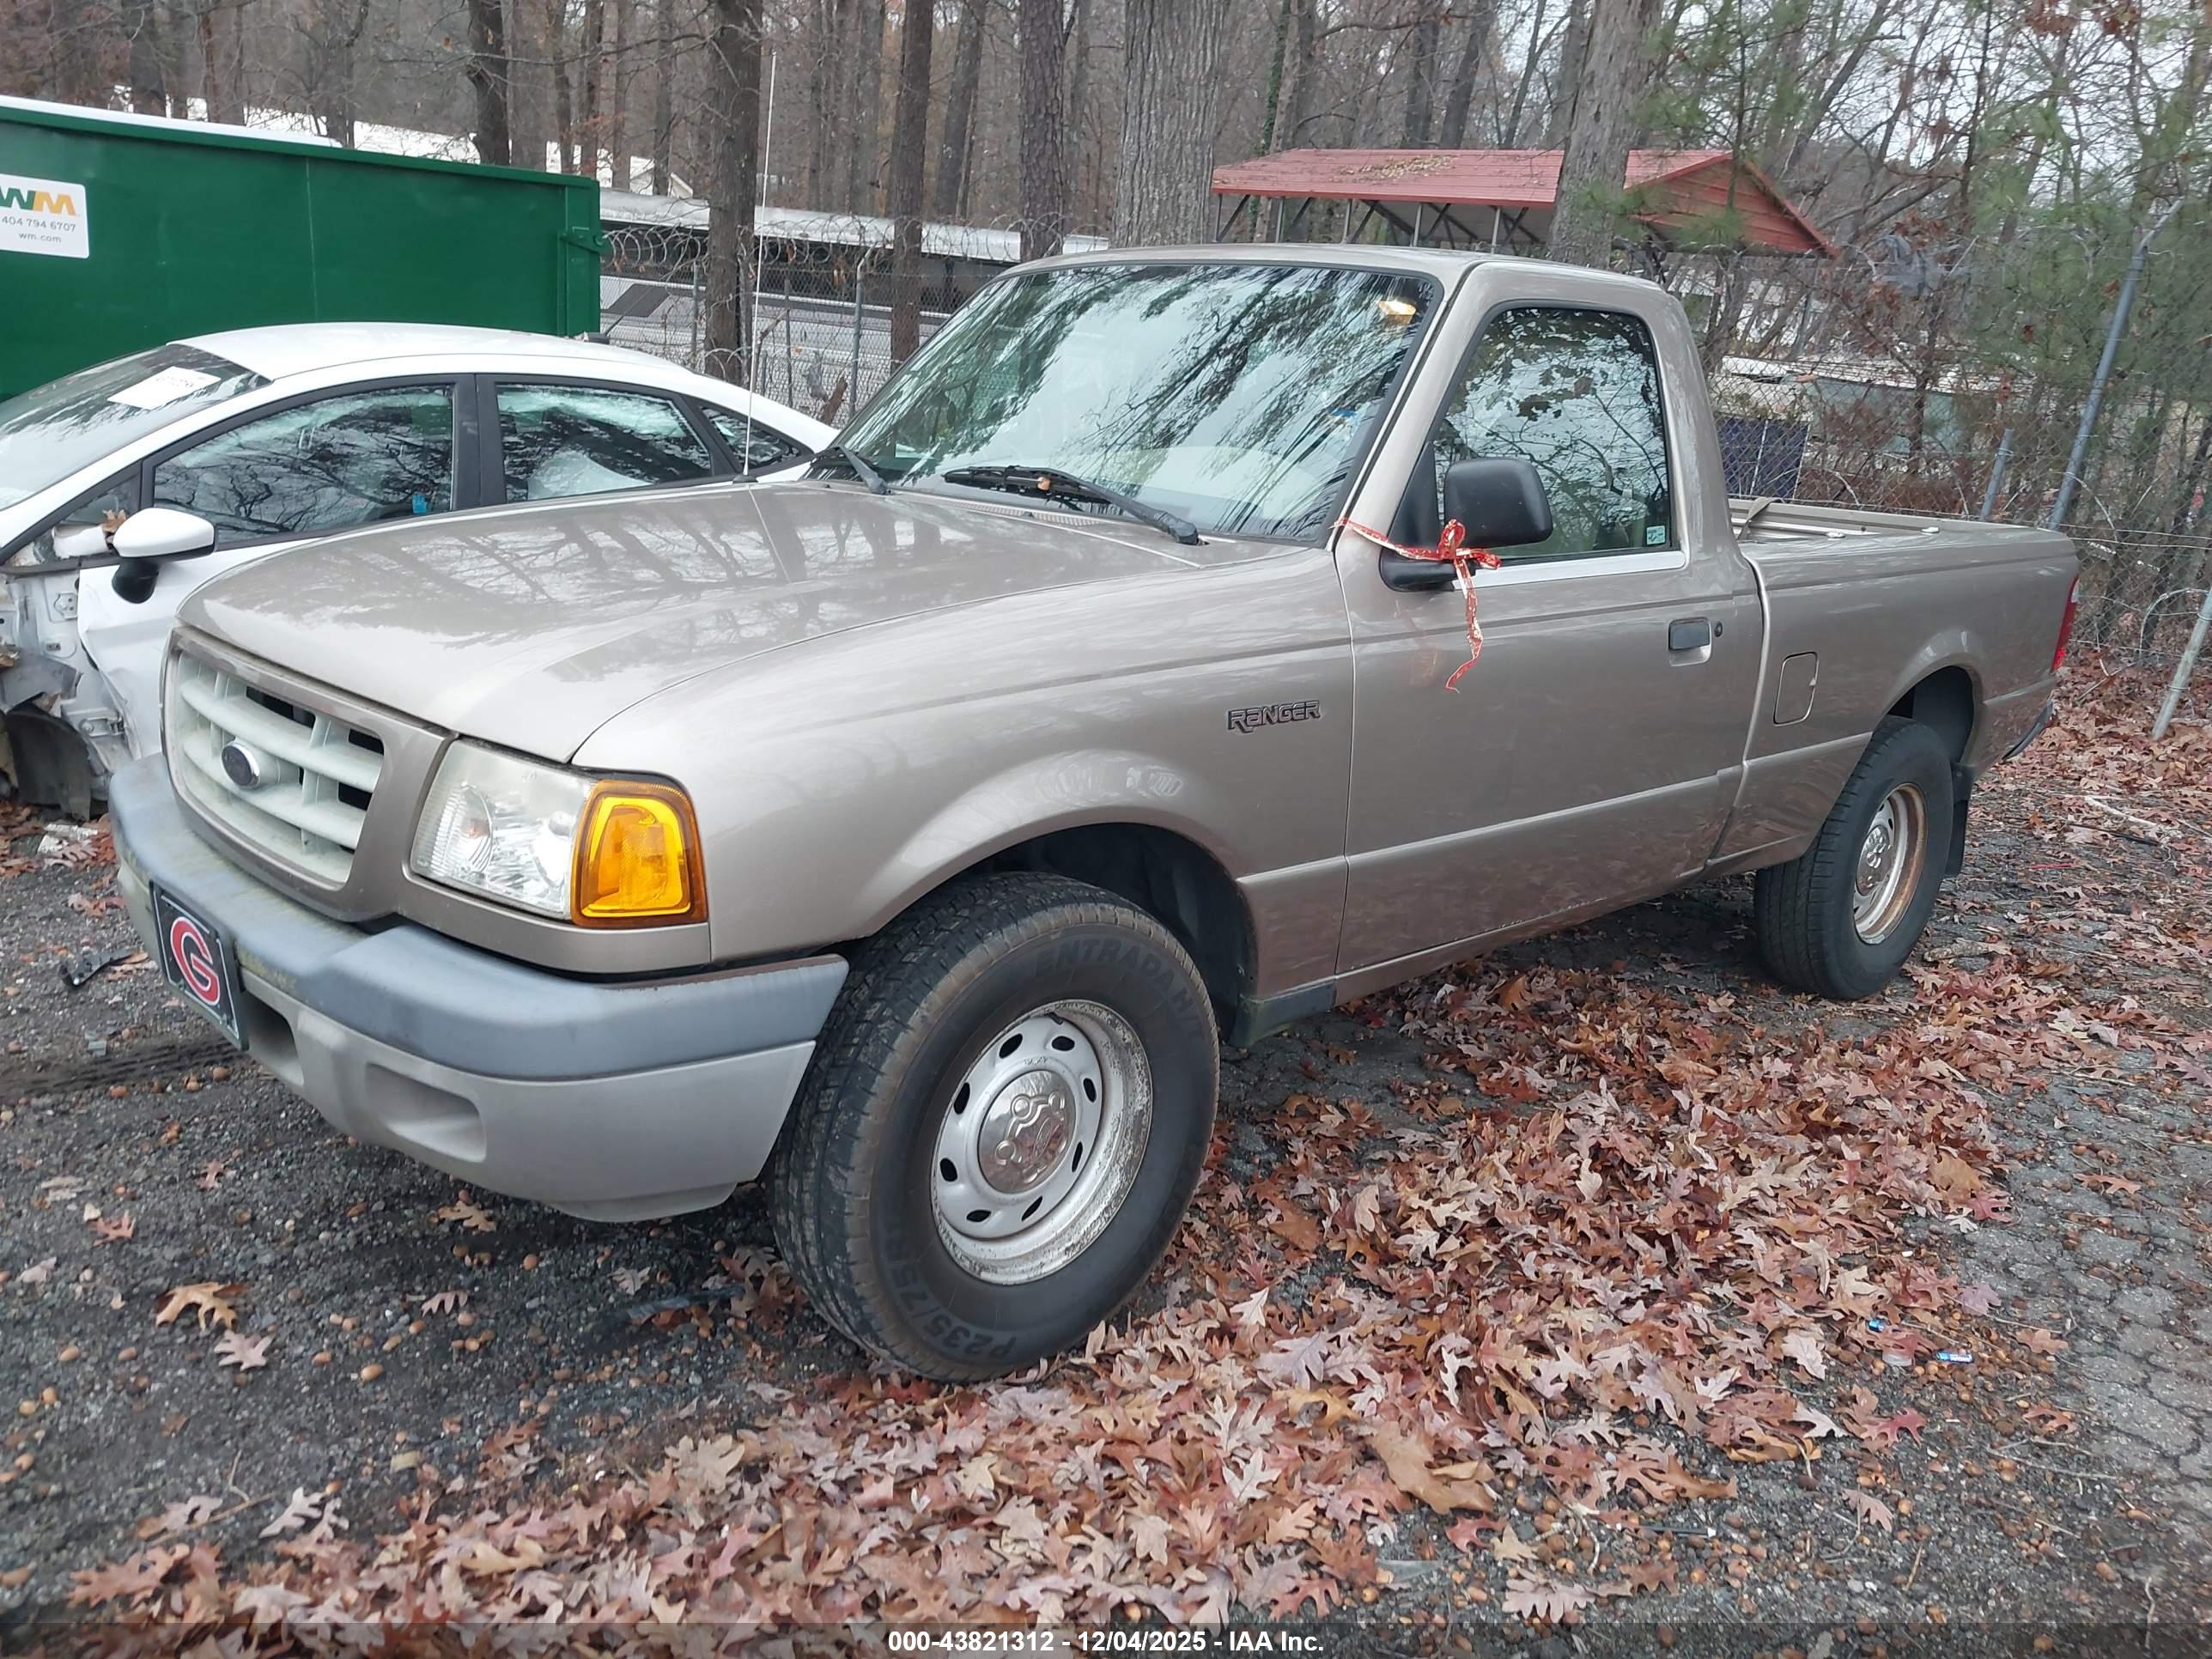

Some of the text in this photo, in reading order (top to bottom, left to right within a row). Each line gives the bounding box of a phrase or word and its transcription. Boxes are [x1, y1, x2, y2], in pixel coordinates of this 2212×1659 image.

[0, 186, 76, 216] WM
[2, 216, 76, 233] 404 794 6707
[18, 233, 62, 243] wm.com
[170, 916, 220, 1006] G
